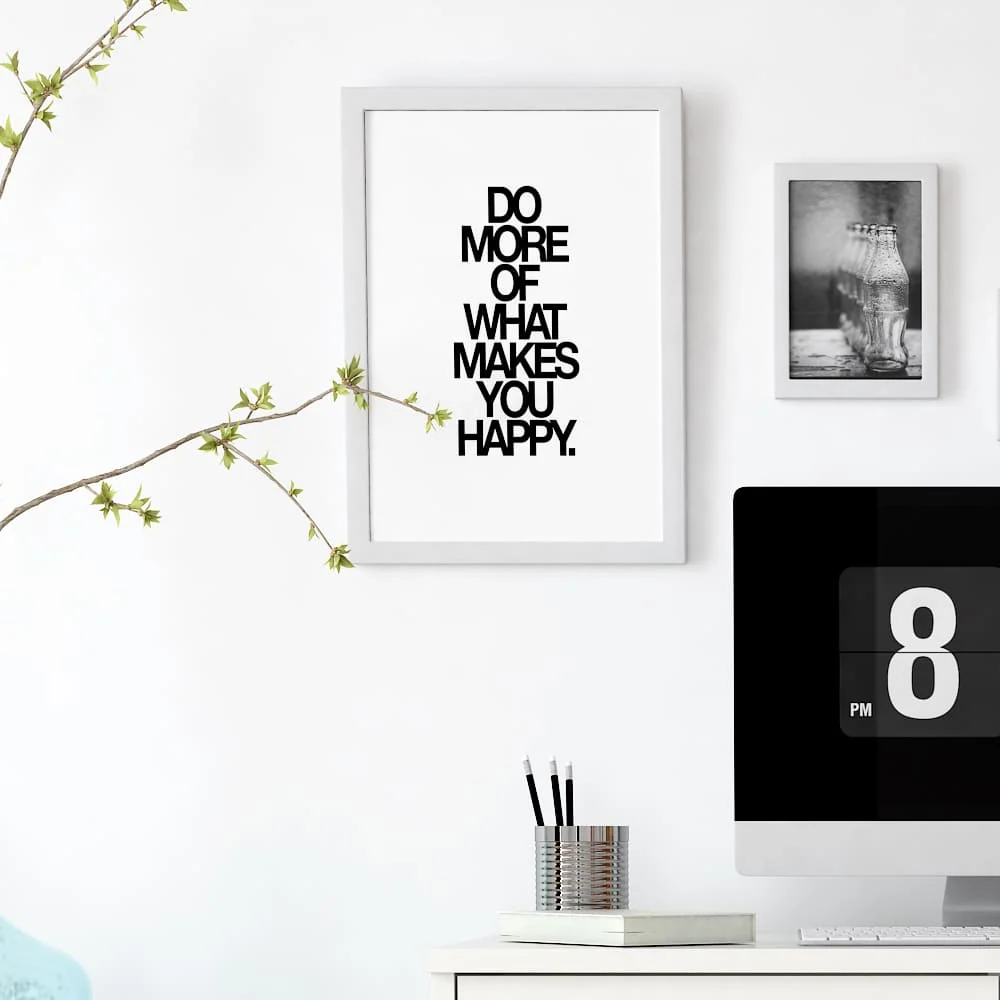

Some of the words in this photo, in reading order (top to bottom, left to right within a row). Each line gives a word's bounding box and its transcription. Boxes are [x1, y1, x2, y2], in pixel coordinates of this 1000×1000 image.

[488, 186, 542, 224] DO
[462, 225, 570, 263] MORE
[491, 264, 541, 301] OF
[463, 303, 568, 340] WHAT
[453, 341, 580, 379] MAKES
[476, 380, 554, 418] YOU
[458, 419, 577, 457] HAPPY.
[887, 586, 960, 719] 8
[849, 702, 872, 717] PM
